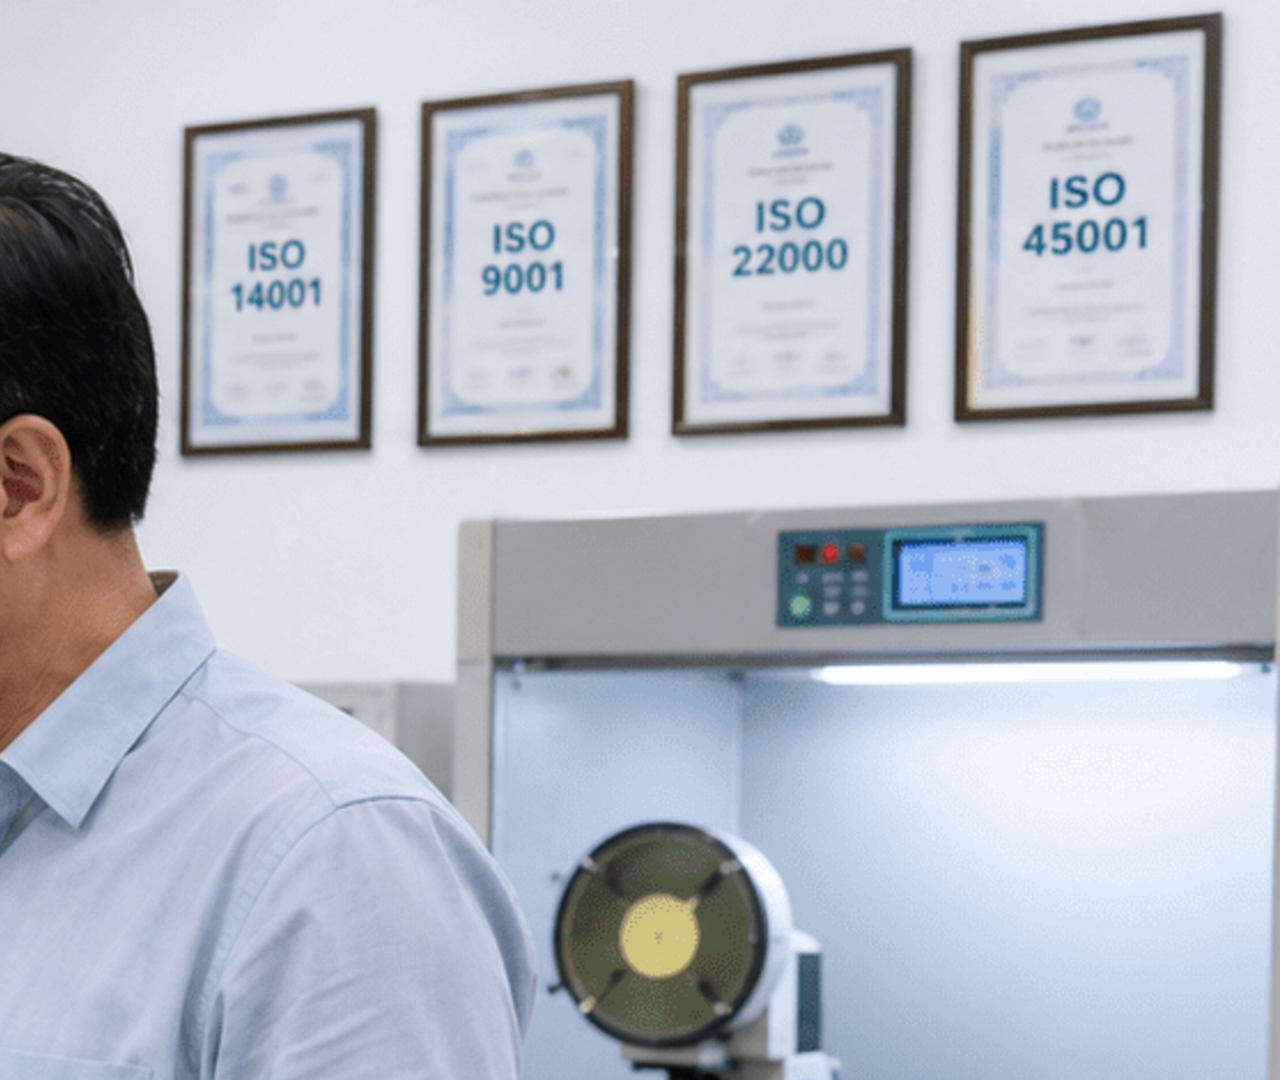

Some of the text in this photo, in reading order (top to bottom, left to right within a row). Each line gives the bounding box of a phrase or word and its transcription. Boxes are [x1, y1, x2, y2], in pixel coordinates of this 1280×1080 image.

[1050, 172, 1126, 209] ISO
[755, 197, 827, 233] ISO
[493, 220, 556, 254] ISO
[1022, 216, 1148, 256] 45001
[248, 239, 306, 272] ISO
[732, 238, 849, 278] 22000
[231, 278, 322, 312] 14001
[481, 261, 565, 296] 9001
